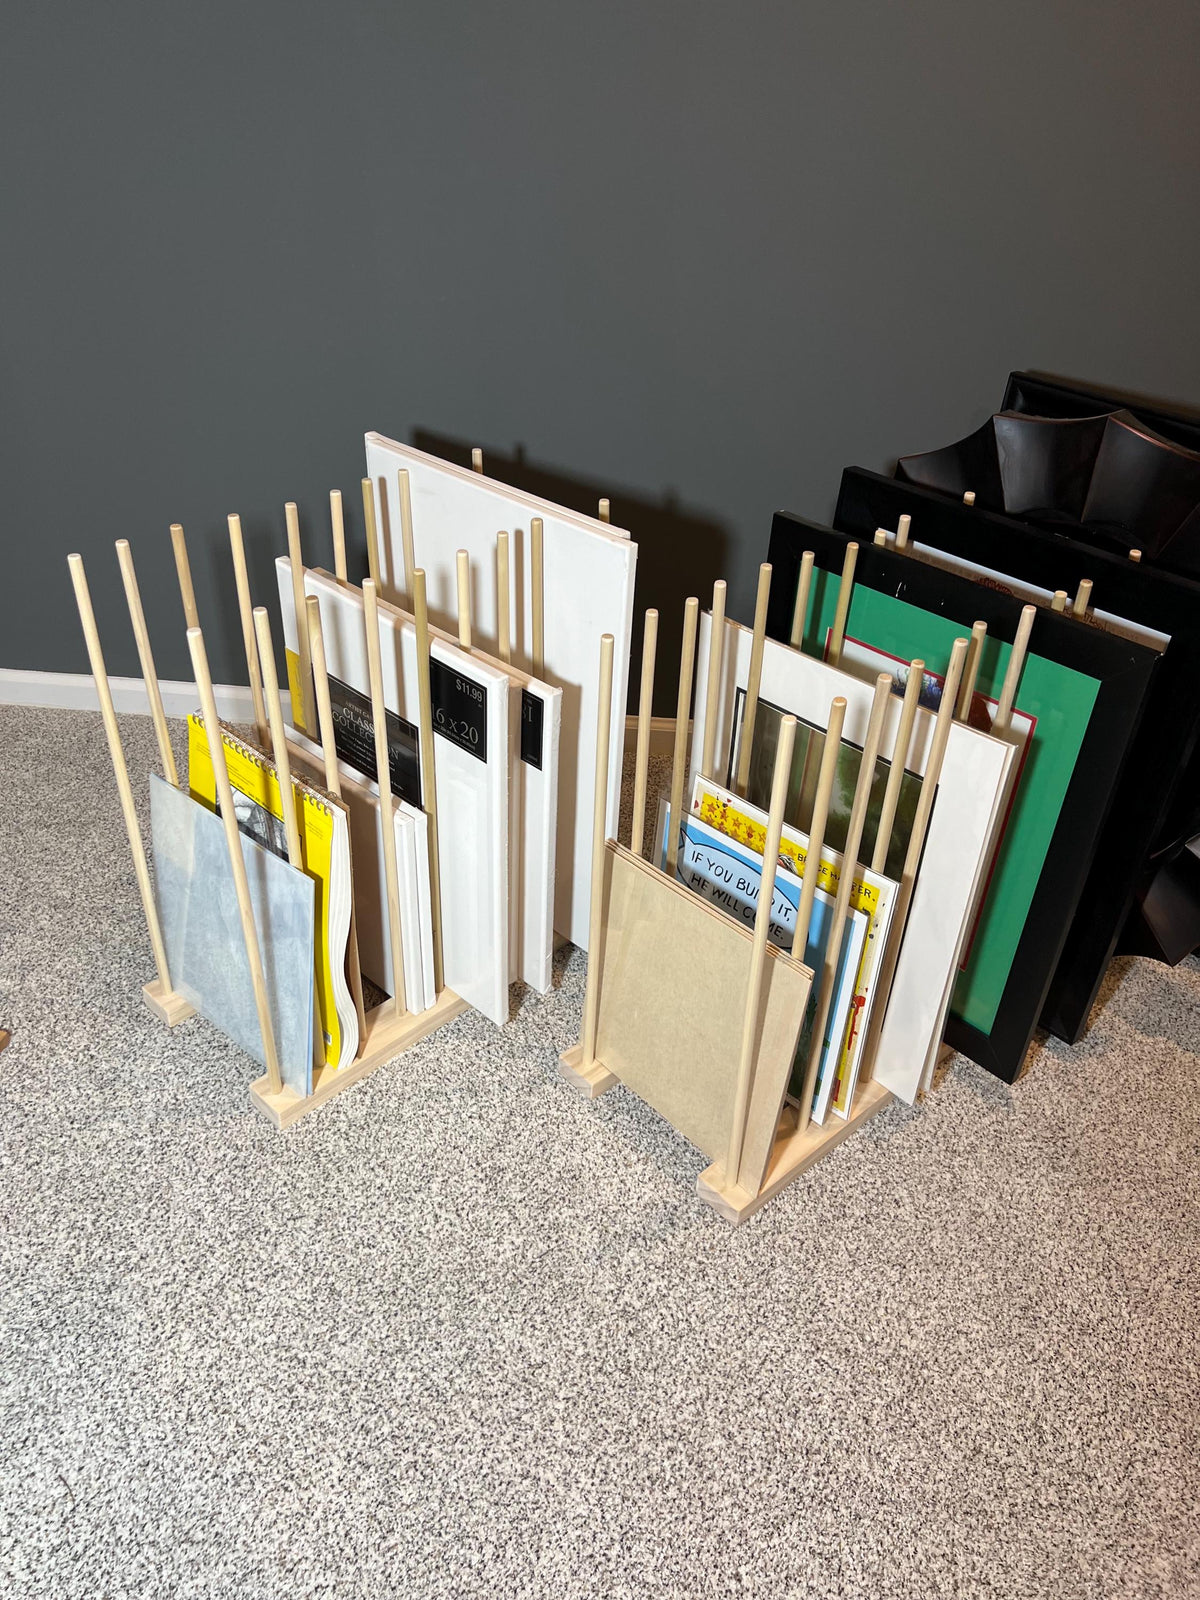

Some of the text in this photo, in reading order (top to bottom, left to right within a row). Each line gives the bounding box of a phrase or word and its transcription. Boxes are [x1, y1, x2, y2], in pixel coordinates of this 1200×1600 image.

[456, 679, 483, 702] $11.99
[332, 711, 399, 760] COLLECN
[343, 707, 375, 733] CLASS
[449, 718, 457, 732] x
[460, 721, 479, 744] 20
[691, 850, 792, 922] IF YOU BUI IT,
[691, 873, 710, 890] HE
[712, 887, 739, 912] WILL
